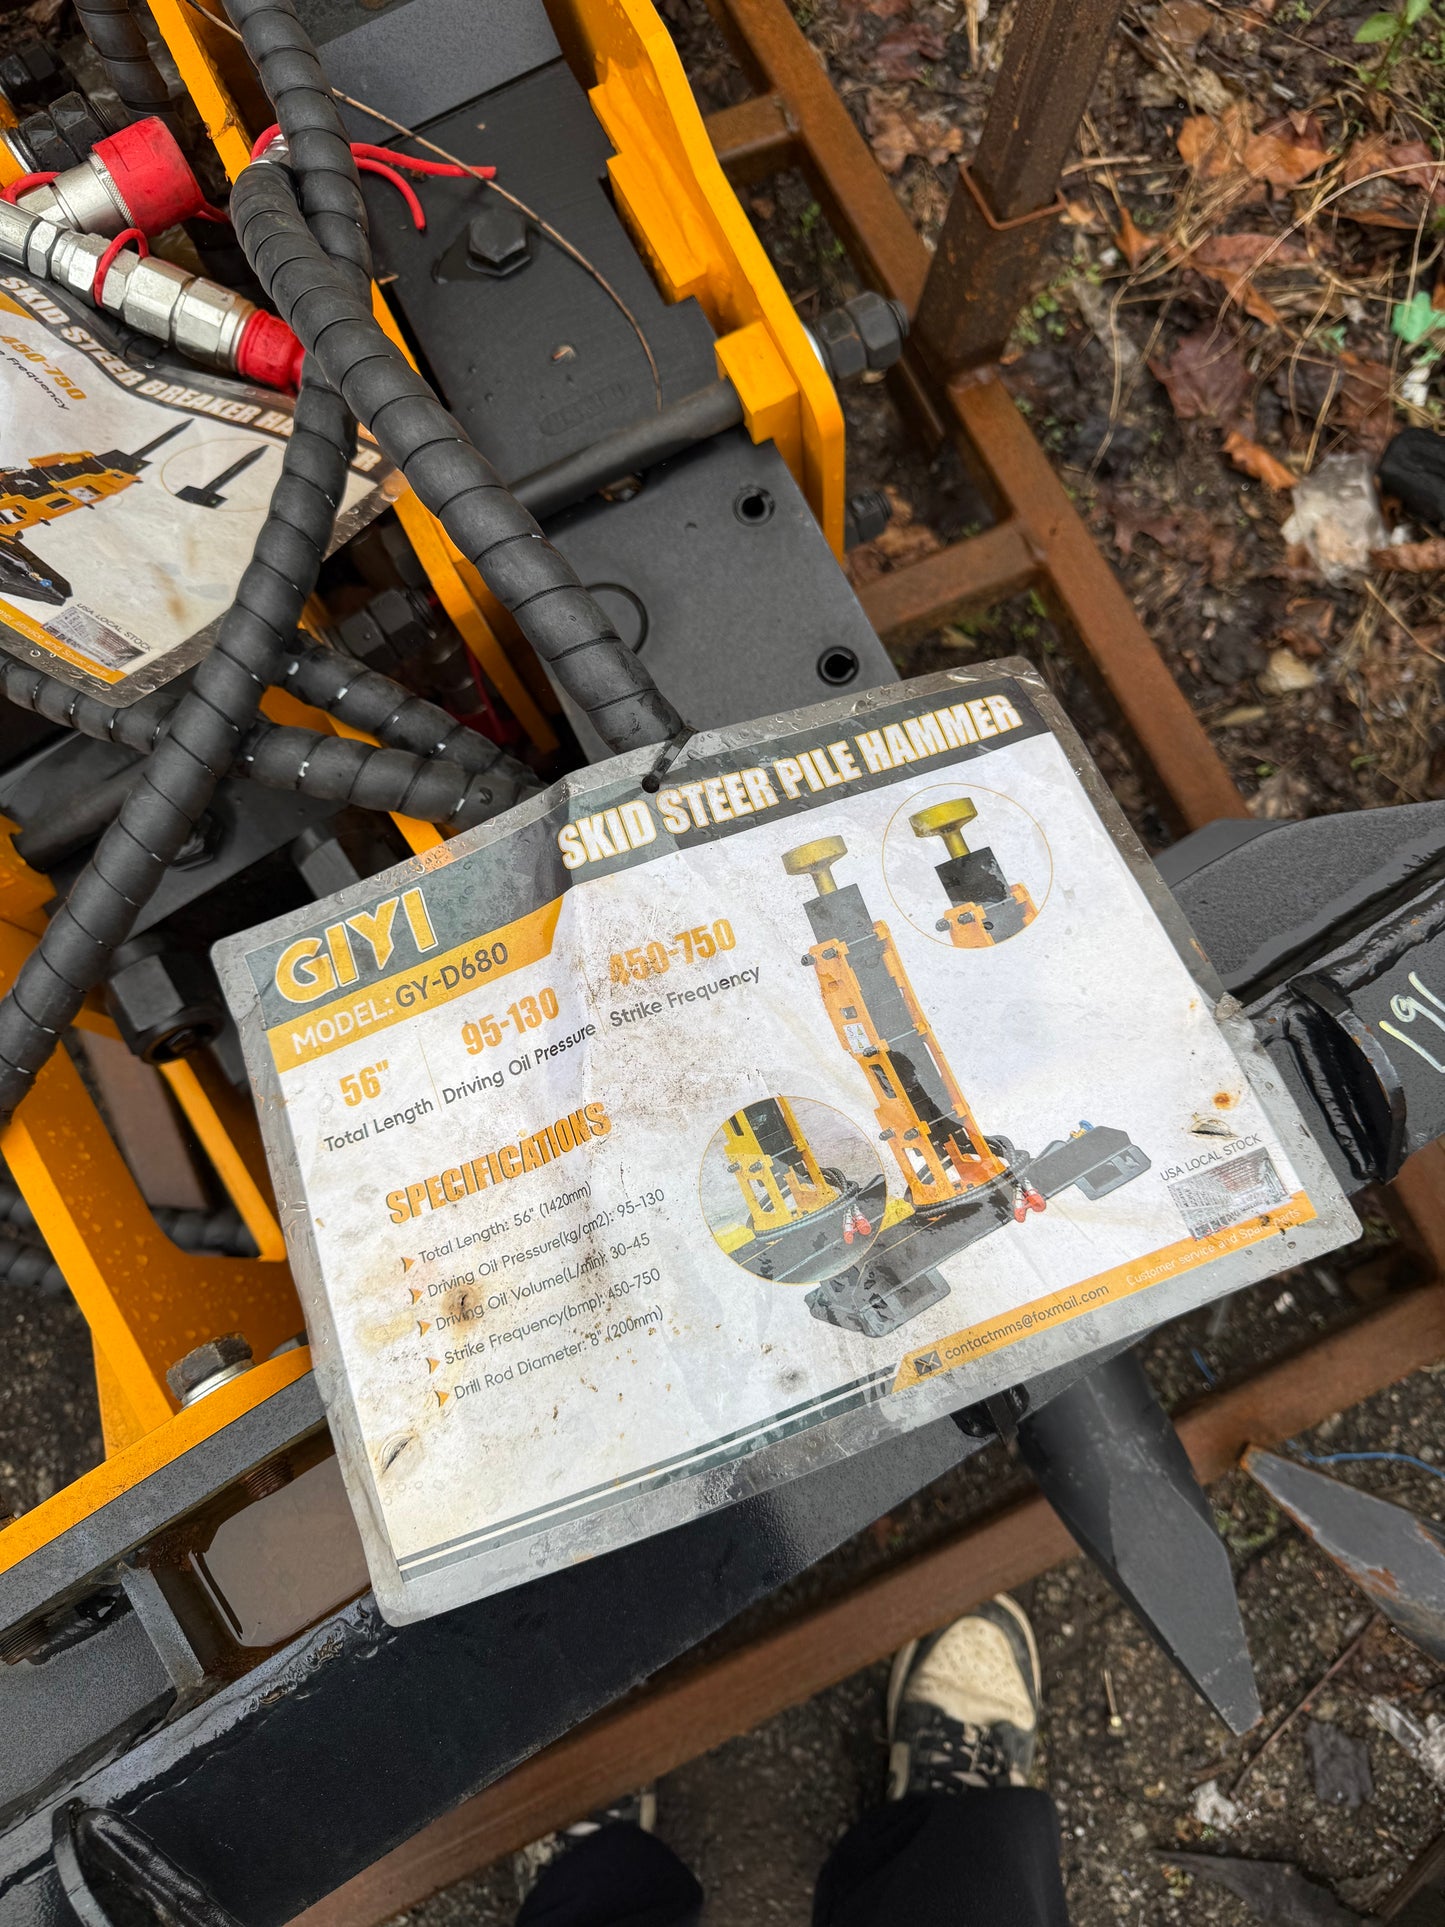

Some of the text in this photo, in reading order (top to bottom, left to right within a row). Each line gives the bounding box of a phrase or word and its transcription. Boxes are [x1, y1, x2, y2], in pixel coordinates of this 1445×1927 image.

[0, 277, 70, 324] SKID
[61, 326, 146, 387] STEER
[136, 379, 262, 424] BREAKER
[0, 335, 87, 400] 450-750
[7, 357, 70, 411] Frequency
[77, 603, 152, 652] USA LOCAL STOCK
[557, 695, 1024, 870] SKID STEER PILE HAMMER
[275, 887, 439, 1004] GIYI
[291, 943, 509, 1055] MODEL: GY-D680
[338, 918, 737, 1107] 56" 95-130 450-750
[609, 966, 760, 1028] Strike Frequency
[442, 1023, 596, 1105] Driving Oil Pressure
[324, 1098, 434, 1152] Total Length
[385, 1101, 613, 1225] SPECIFICATIONS
[1160, 1133, 1262, 1181] USA LOCAL STOCK
[418, 1180, 592, 1264] Total Length: 56" (1420mm)
[427, 1188, 665, 1298] Driving Oil Pressure(kg/cm2): 95-130
[1126, 1260, 1176, 1287] Customer
[1179, 1243, 1215, 1265] service
[1218, 1234, 1238, 1249] and
[1273, 1208, 1300, 1228] parts
[435, 1232, 650, 1331] Driving Oil Volume(L/min): 30-45
[444, 1268, 660, 1365] Strike Frequency(bmp): 450-750
[944, 1284, 1110, 1360] contactmms@foxmail.com
[454, 1304, 664, 1400] Drill Rod Diameter: 8" (200mm)
